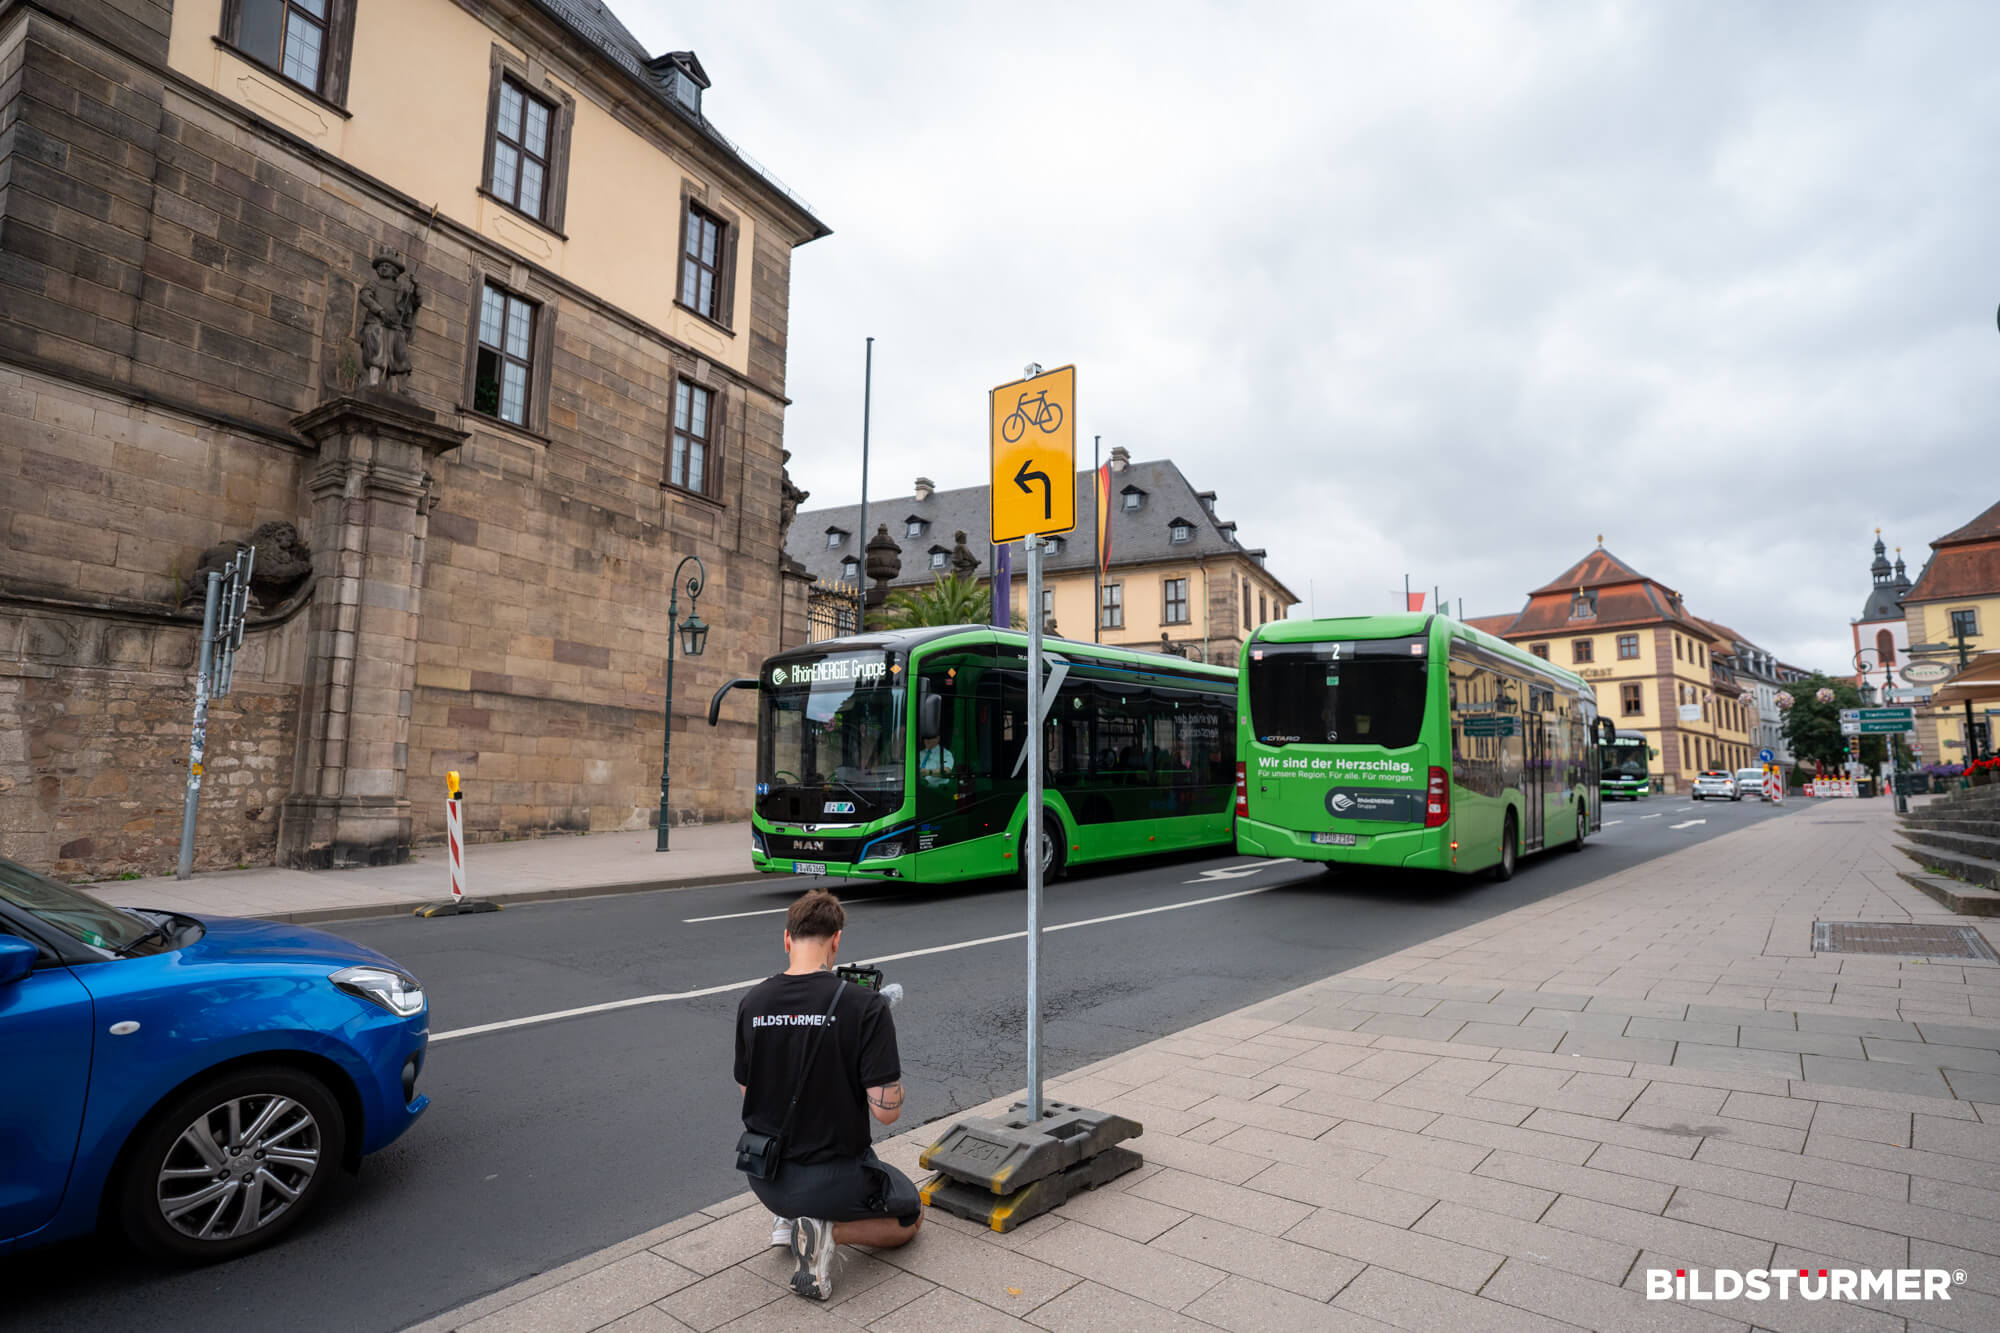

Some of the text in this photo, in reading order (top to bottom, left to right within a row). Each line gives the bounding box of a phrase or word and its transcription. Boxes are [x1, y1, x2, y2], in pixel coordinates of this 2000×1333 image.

[1332, 643, 1340, 660] 2
[791, 659, 886, 684] RhönENERGIE Gruppe
[1258, 757, 1414, 773] Wir sind der Herzschlag.
[1298, 771, 1326, 780] Region.
[1328, 771, 1342, 779] Für
[1344, 772, 1360, 780] alle.
[1362, 772, 1376, 781] Für
[1378, 774, 1414, 782] morgen.
[793, 840, 824, 851] MAN
